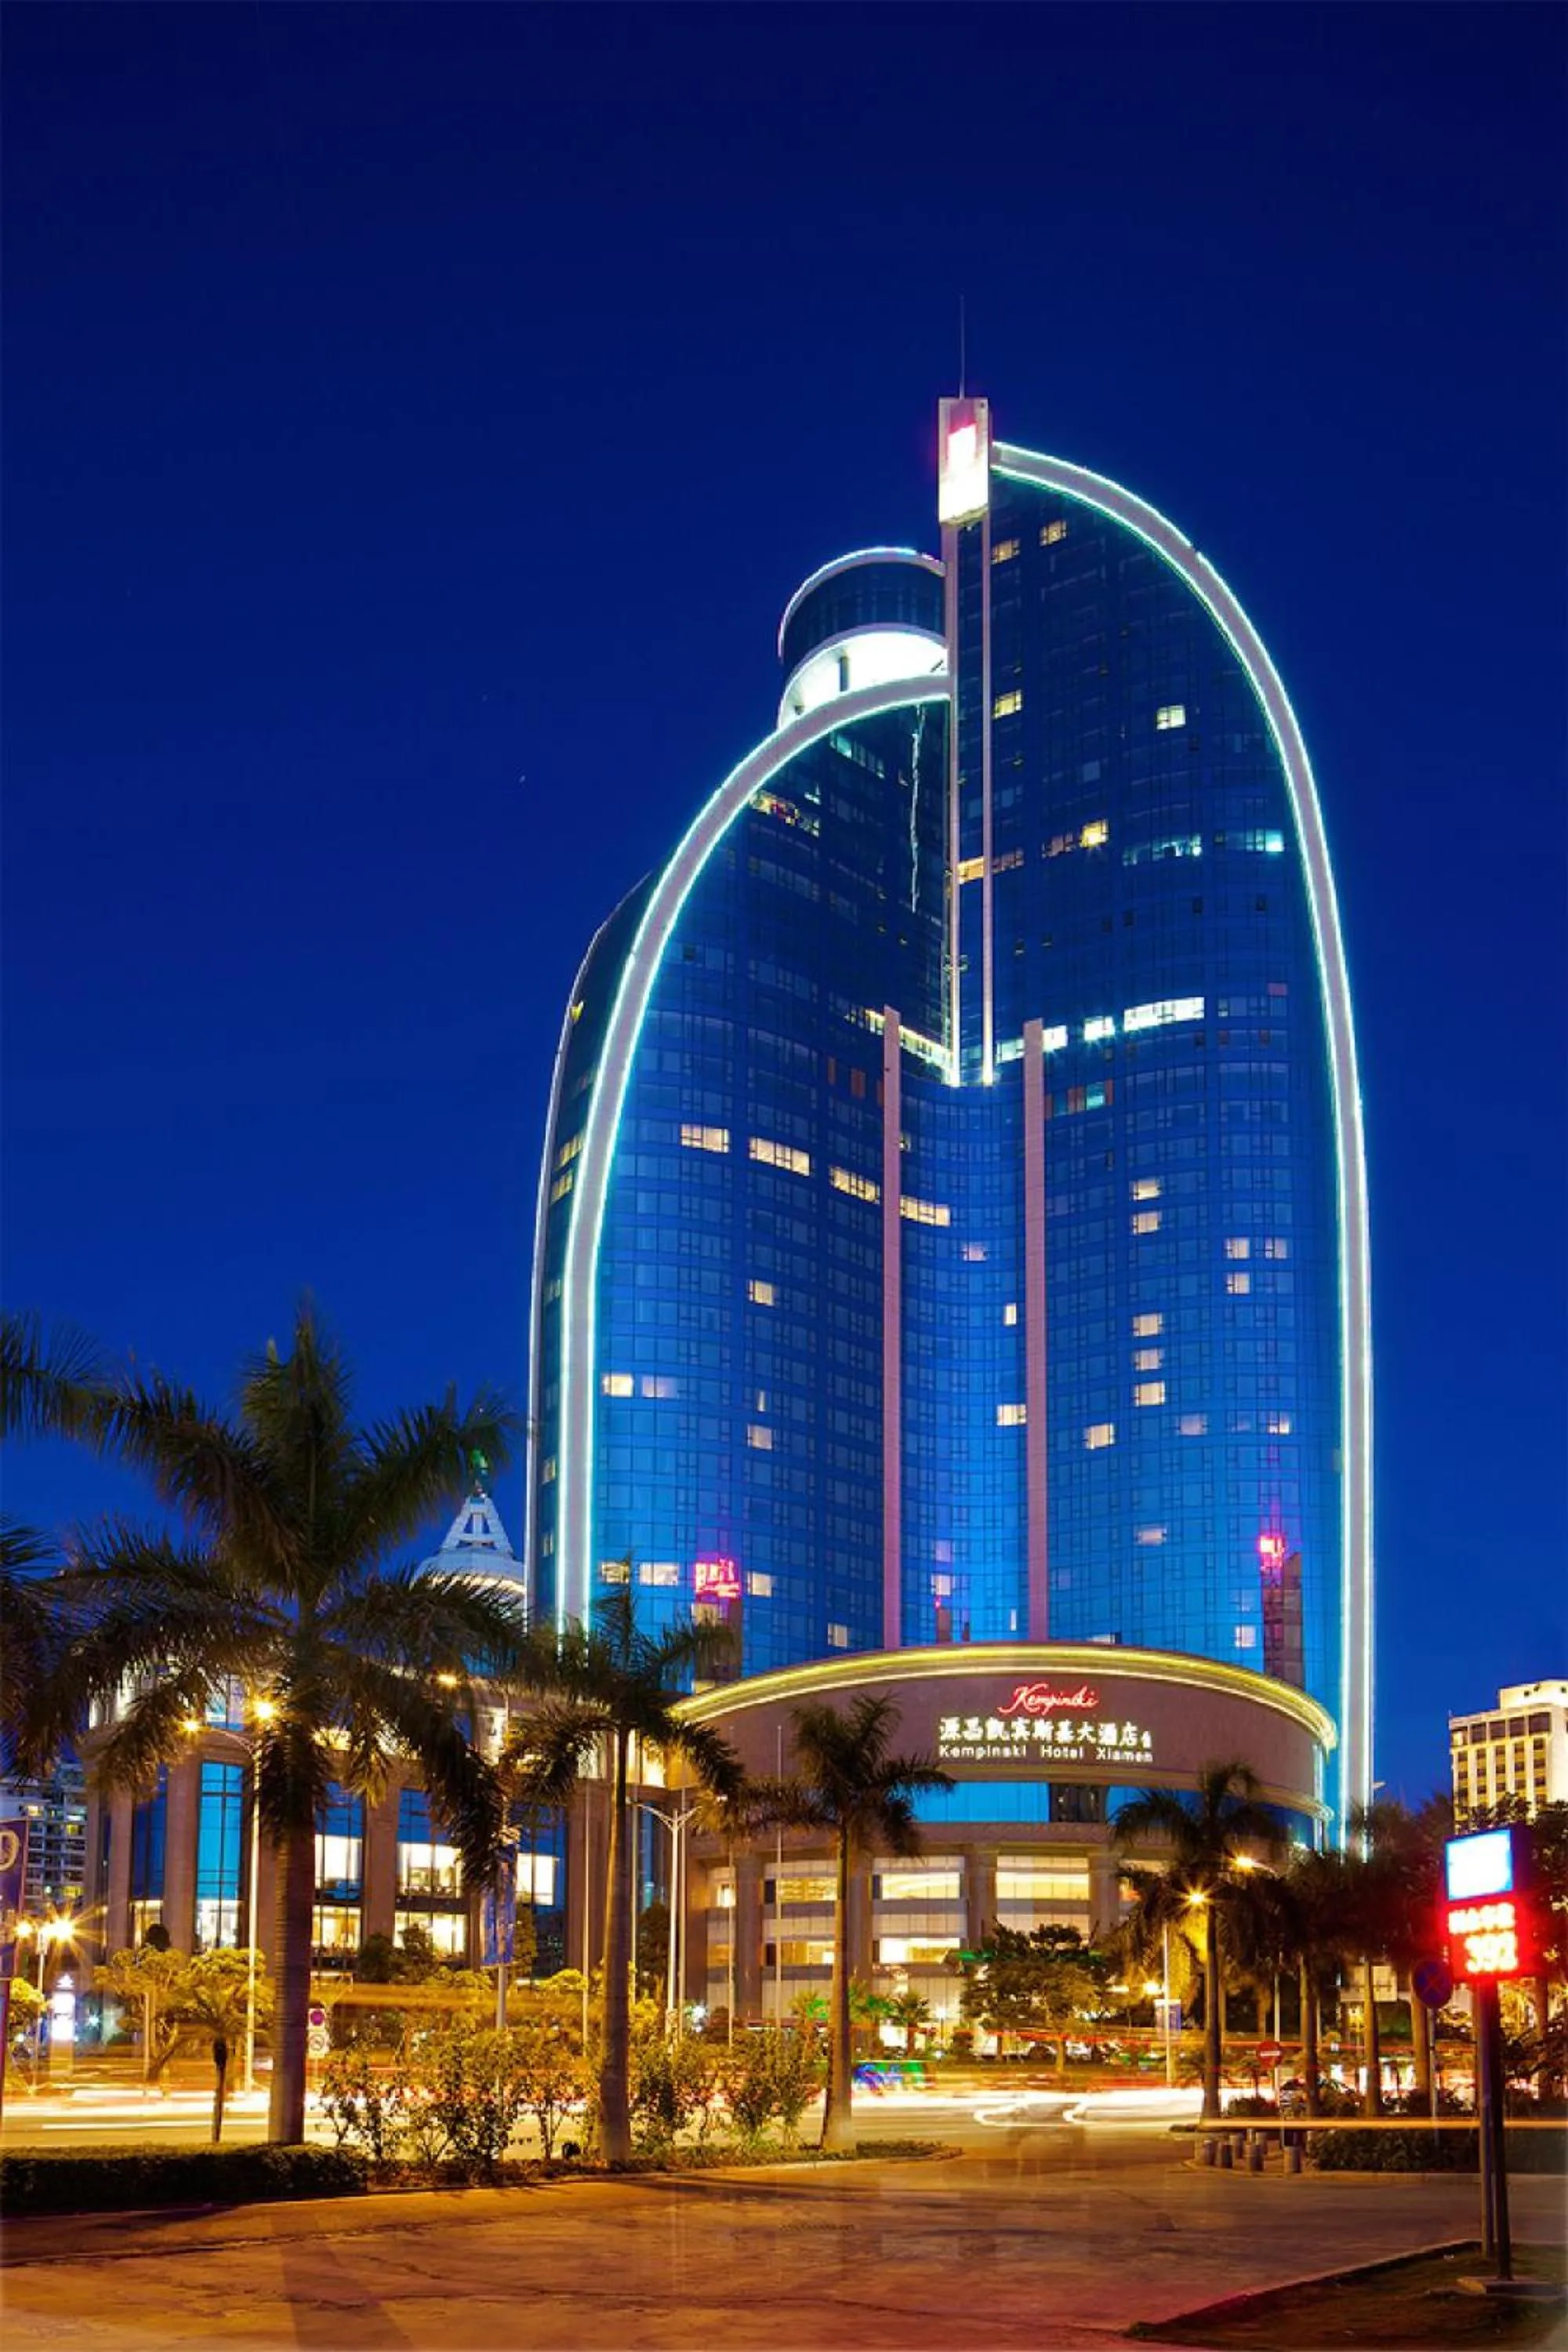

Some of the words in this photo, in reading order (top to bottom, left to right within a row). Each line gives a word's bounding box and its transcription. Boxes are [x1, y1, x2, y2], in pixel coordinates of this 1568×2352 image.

[938, 1745, 1027, 1760] Kempinski
[1040, 1745, 1083, 1759] Hotel
[1095, 1747, 1153, 1762] Xiamen
